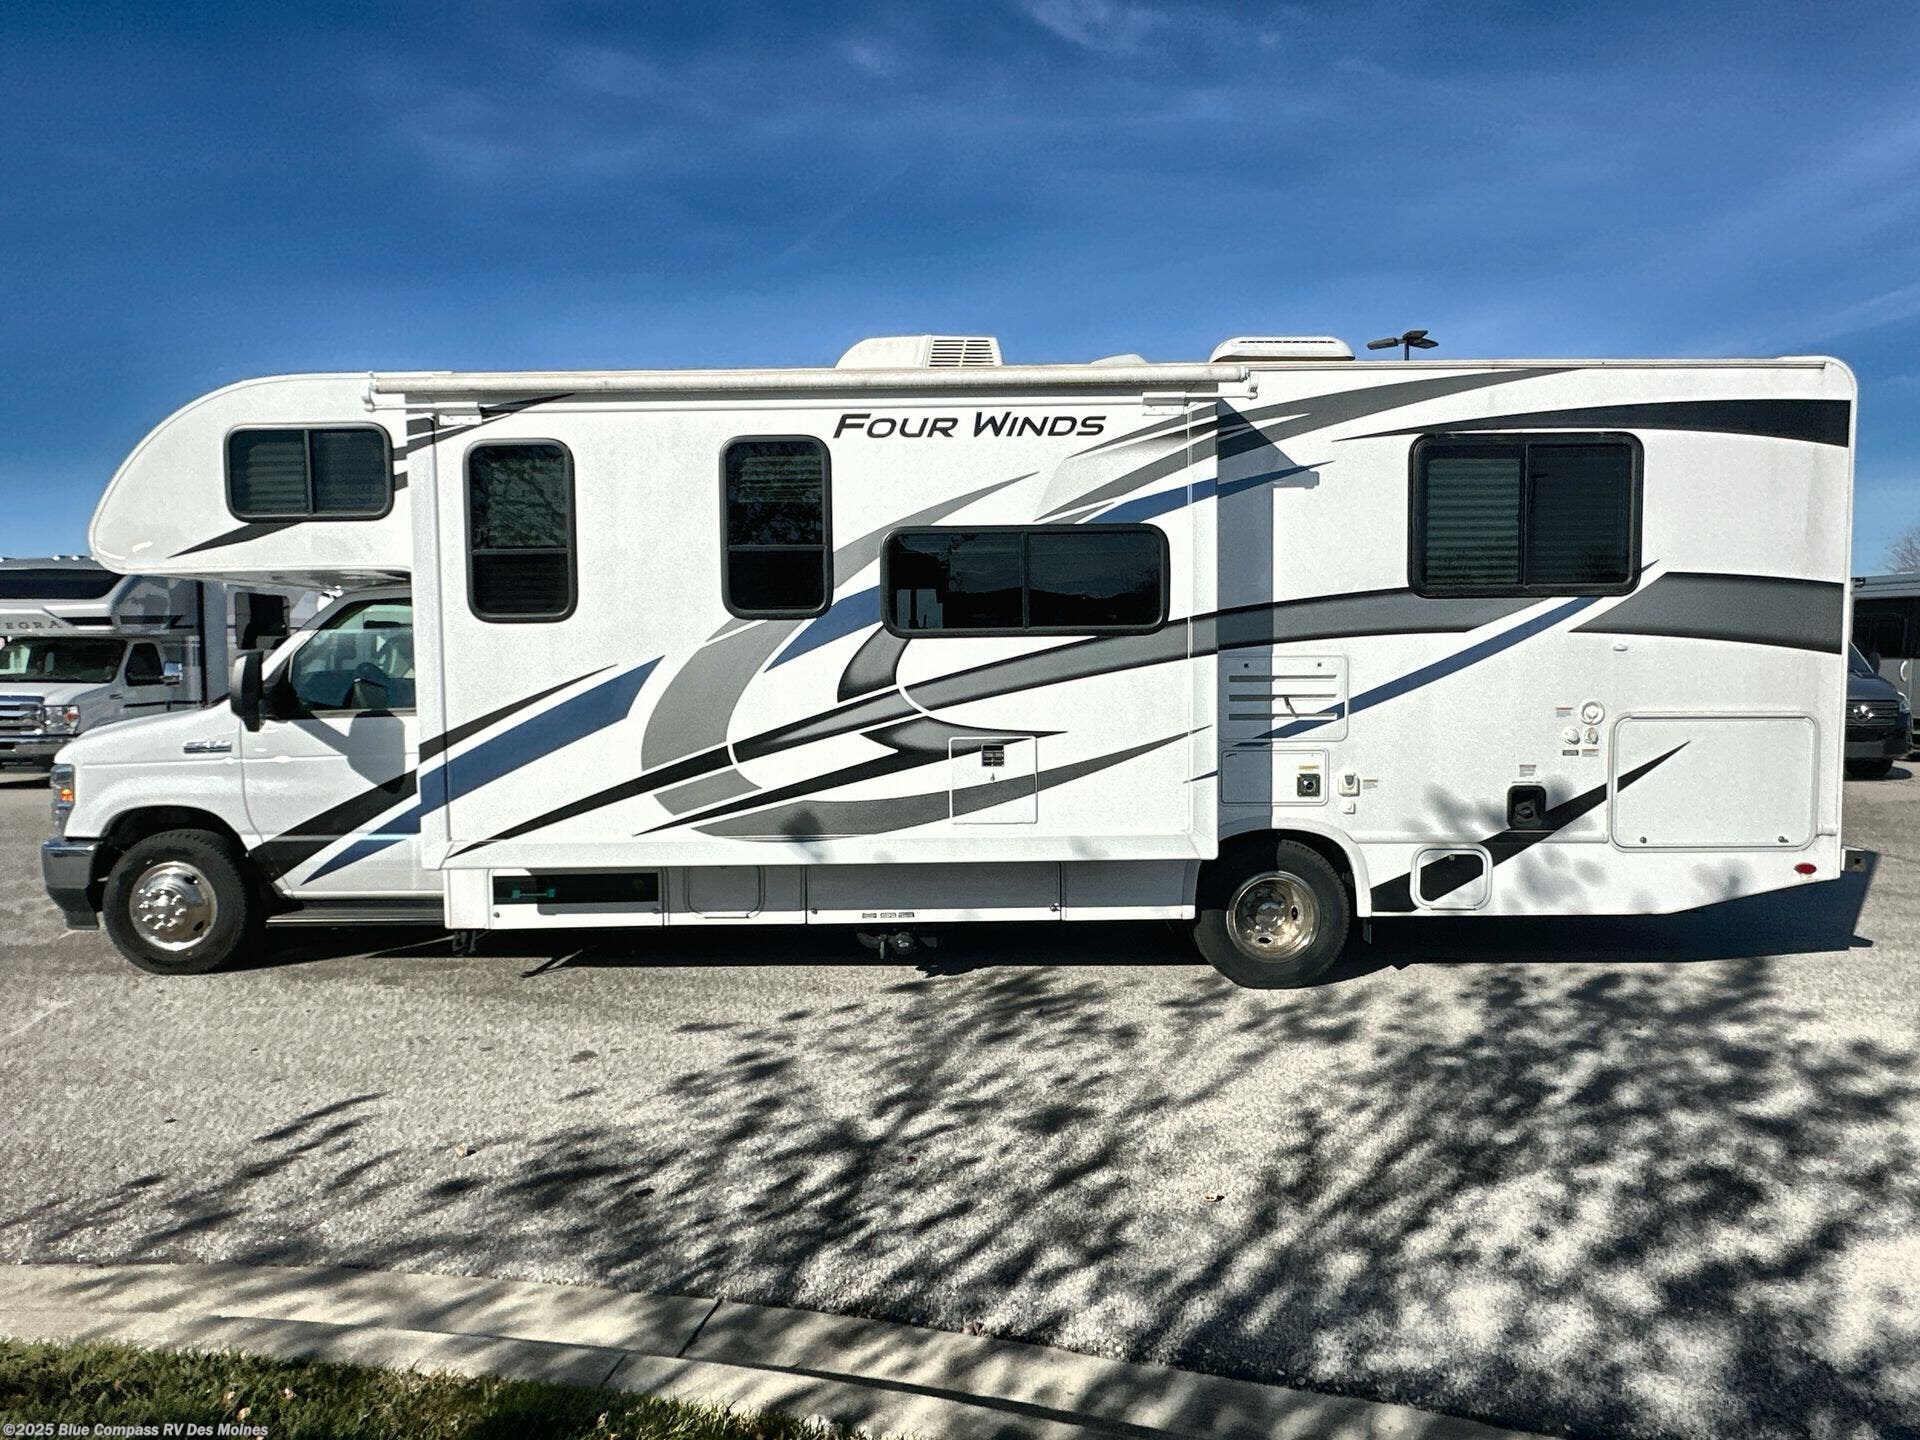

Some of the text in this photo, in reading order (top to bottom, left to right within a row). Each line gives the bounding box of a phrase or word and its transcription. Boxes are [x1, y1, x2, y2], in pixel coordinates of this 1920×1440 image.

[833, 411, 1107, 439] FOUR WINDS
[0, 620, 63, 630] EGRA
